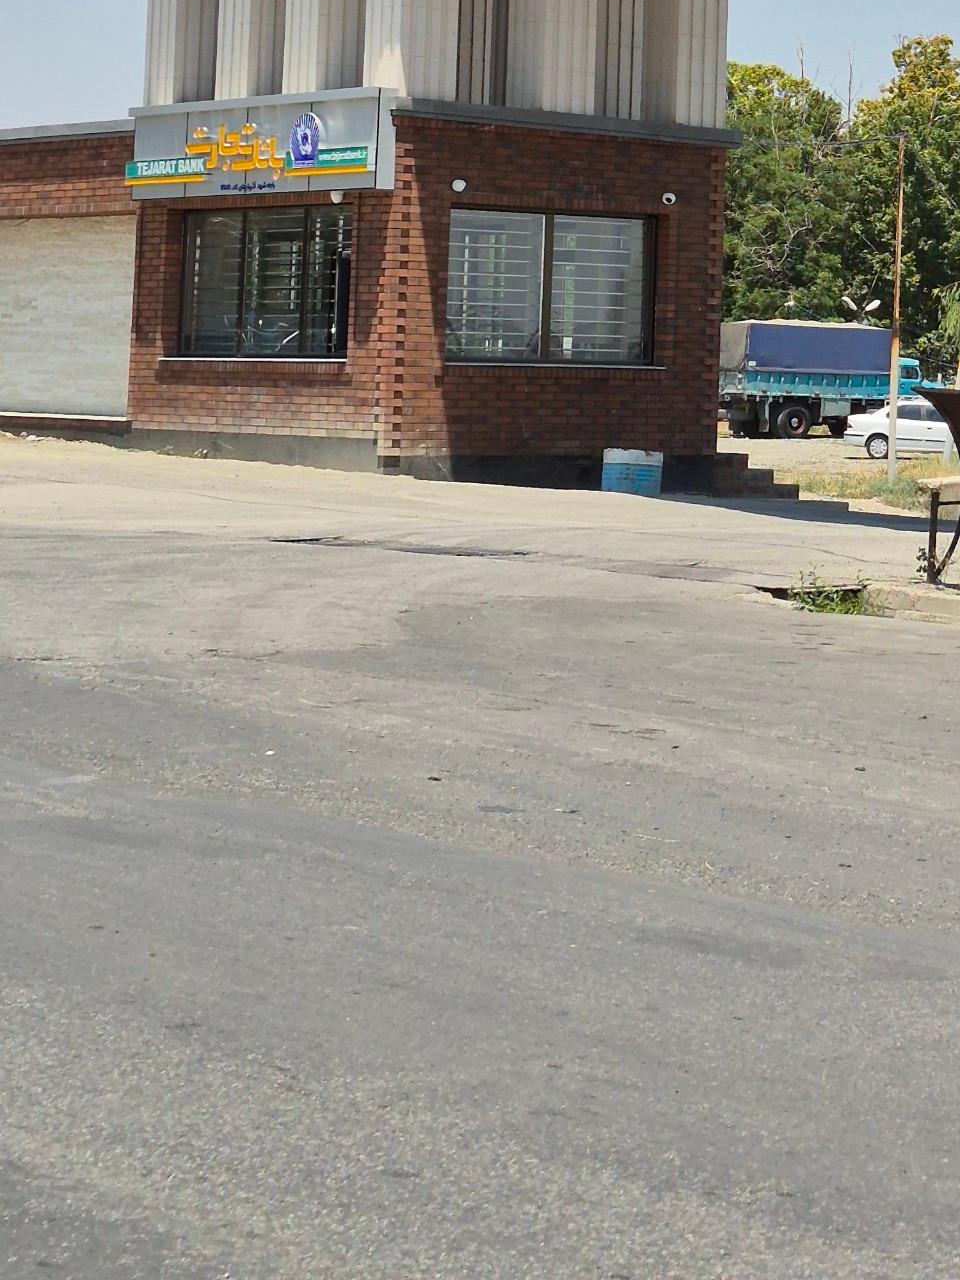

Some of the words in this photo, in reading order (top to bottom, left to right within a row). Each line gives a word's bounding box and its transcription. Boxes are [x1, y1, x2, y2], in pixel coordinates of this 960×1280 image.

[136, 160, 178, 176] TEJARAT
[177, 158, 205, 174] BANK
[185, 121, 257, 172] تجارت
[231, 134, 285, 181] بانک
